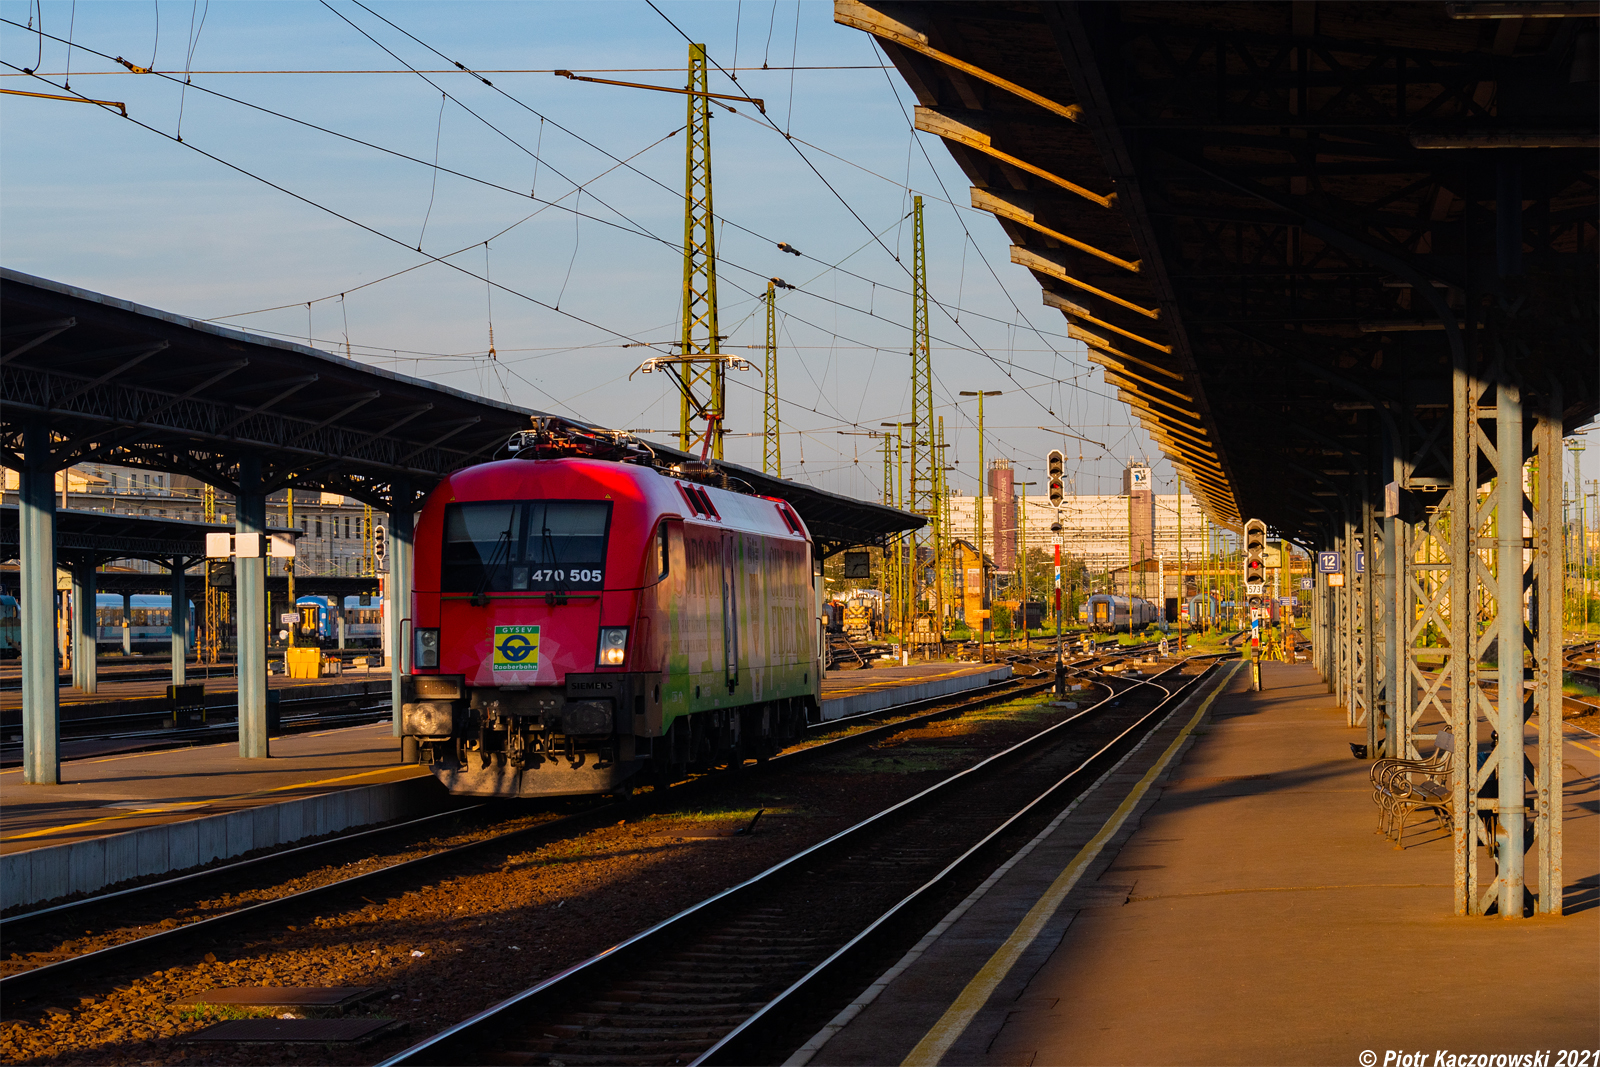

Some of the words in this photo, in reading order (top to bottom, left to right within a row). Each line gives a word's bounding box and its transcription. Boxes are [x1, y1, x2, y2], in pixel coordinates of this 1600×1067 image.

[1322, 555, 1336, 567] 12
[532, 569, 565, 582] 470
[569, 569, 602, 582] 505
[1248, 585, 1261, 593] 573
[571, 682, 613, 690] SIEMENS
